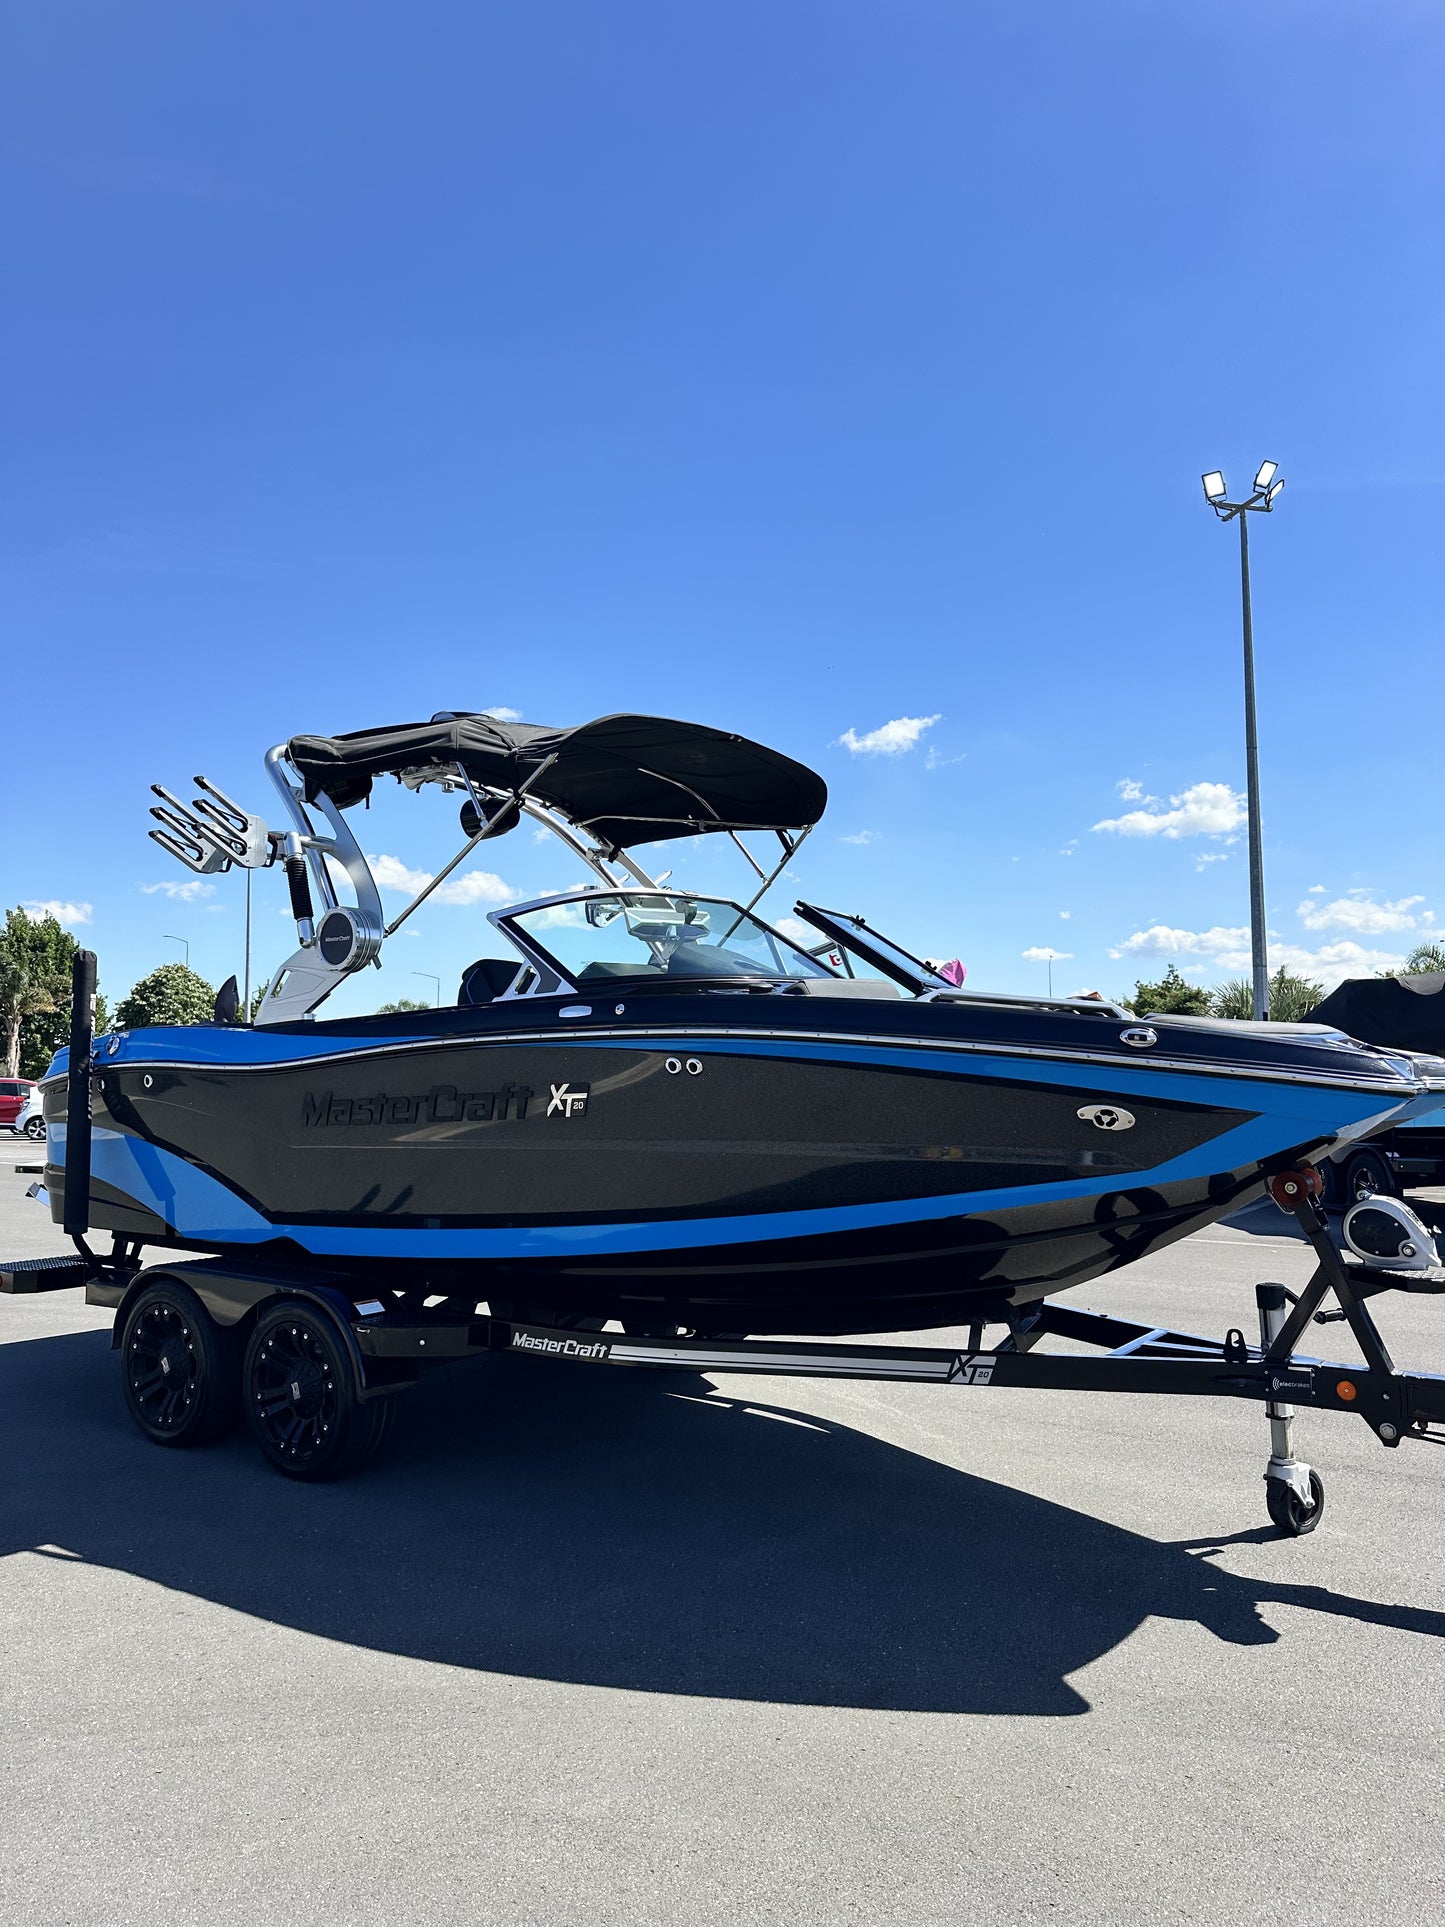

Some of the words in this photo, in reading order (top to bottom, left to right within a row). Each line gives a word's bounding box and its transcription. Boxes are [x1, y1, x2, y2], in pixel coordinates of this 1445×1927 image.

[302, 1081, 534, 1128] MasterCraft
[547, 1083, 588, 1117] XT
[573, 1101, 584, 1110] 20
[512, 1332, 608, 1358] MasterCraft
[1279, 1380, 1311, 1389] elecbrakes
